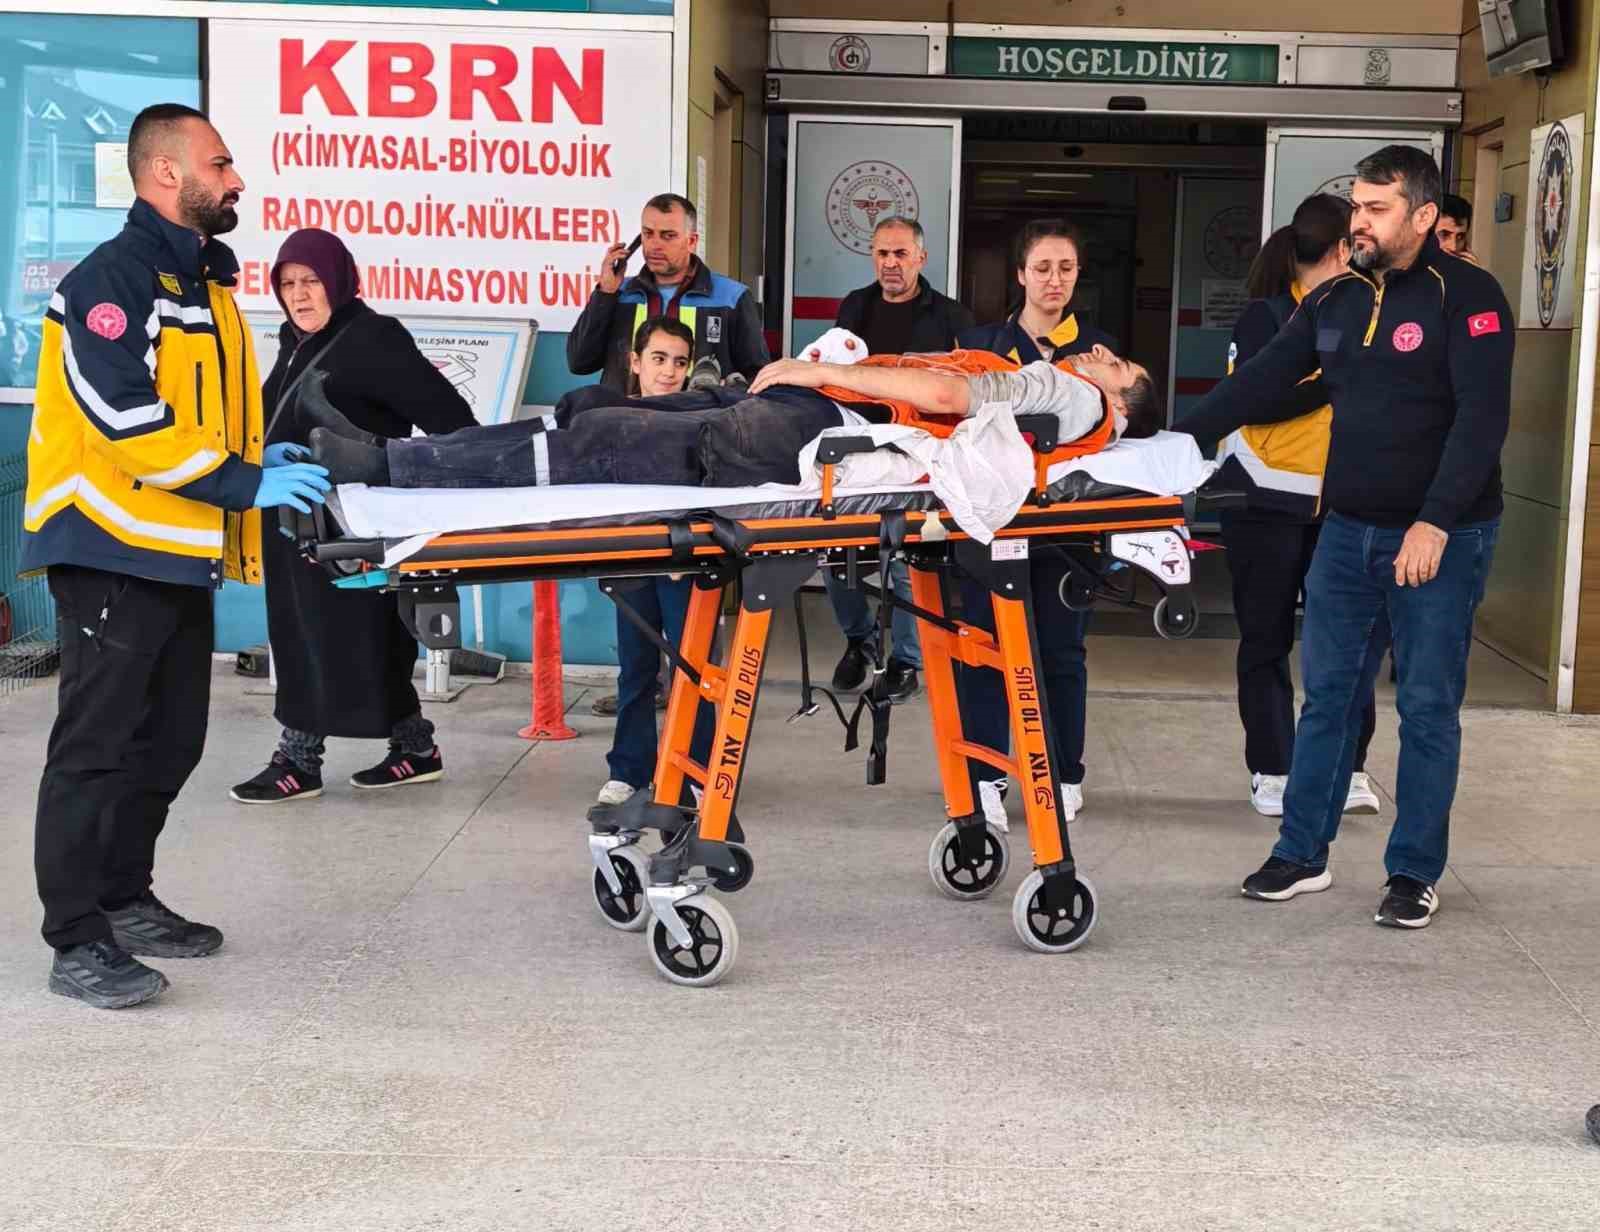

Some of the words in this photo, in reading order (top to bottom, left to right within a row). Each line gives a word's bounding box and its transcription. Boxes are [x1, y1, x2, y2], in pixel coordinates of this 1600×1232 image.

[279, 38, 605, 126] KBRN
[997, 44, 1228, 80] HOŞGELDİNİZ
[272, 124, 612, 178] (KİMYASAL-BİYOLOJİK
[263, 194, 620, 244] RADYOLOJİK-NÜKLEER)
[720, 734, 742, 767] TAY
[738, 645, 761, 687] PLUS
[1014, 666, 1036, 701] PLUS
[1029, 751, 1049, 783] TAY
